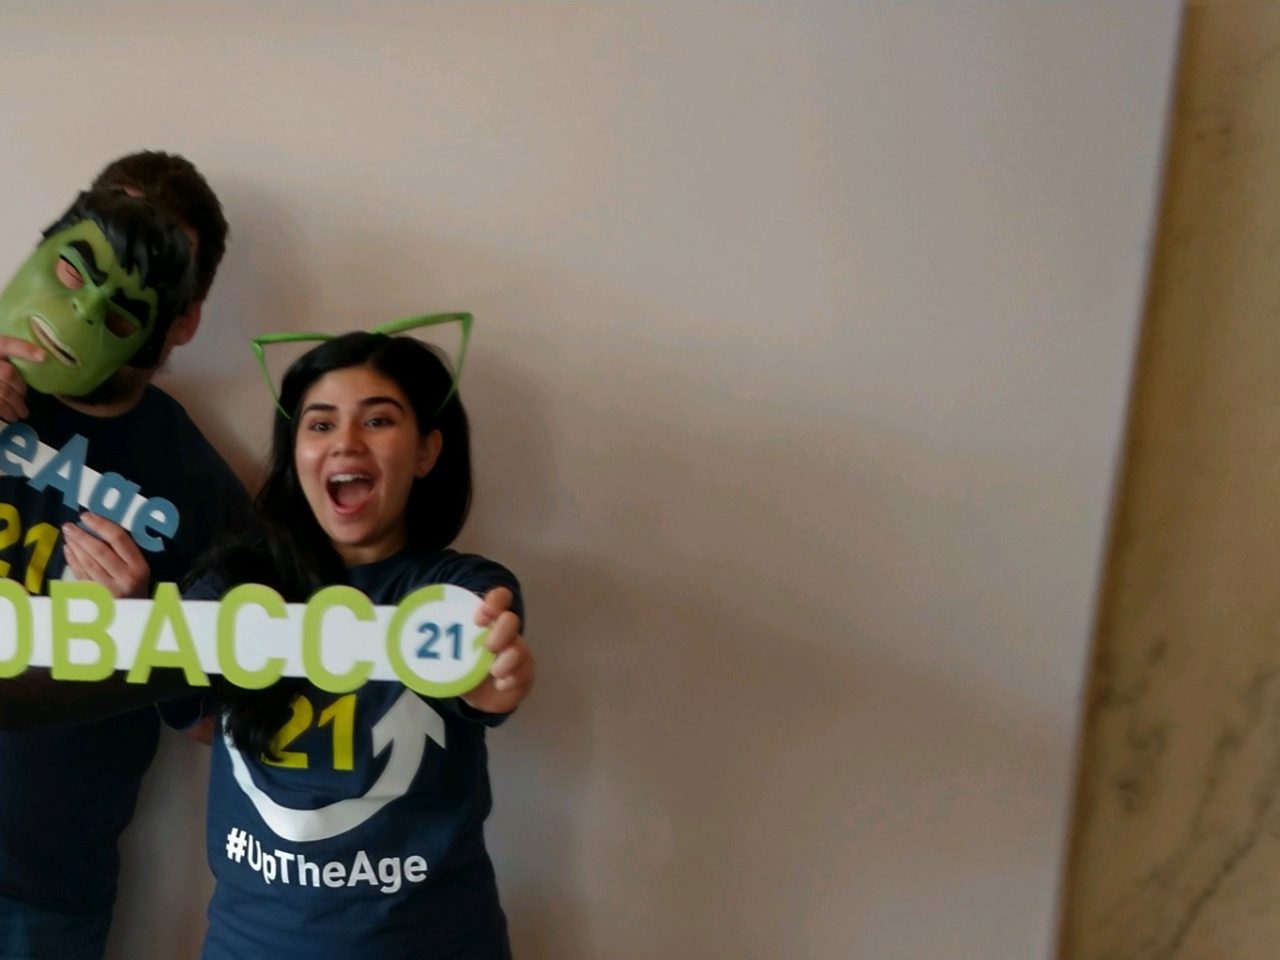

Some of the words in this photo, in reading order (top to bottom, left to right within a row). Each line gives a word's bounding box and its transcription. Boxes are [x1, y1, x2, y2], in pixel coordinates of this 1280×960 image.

[416, 622, 464, 660] 21
[261, 693, 357, 771] 21
[225, 827, 429, 894] #UpTheAge
